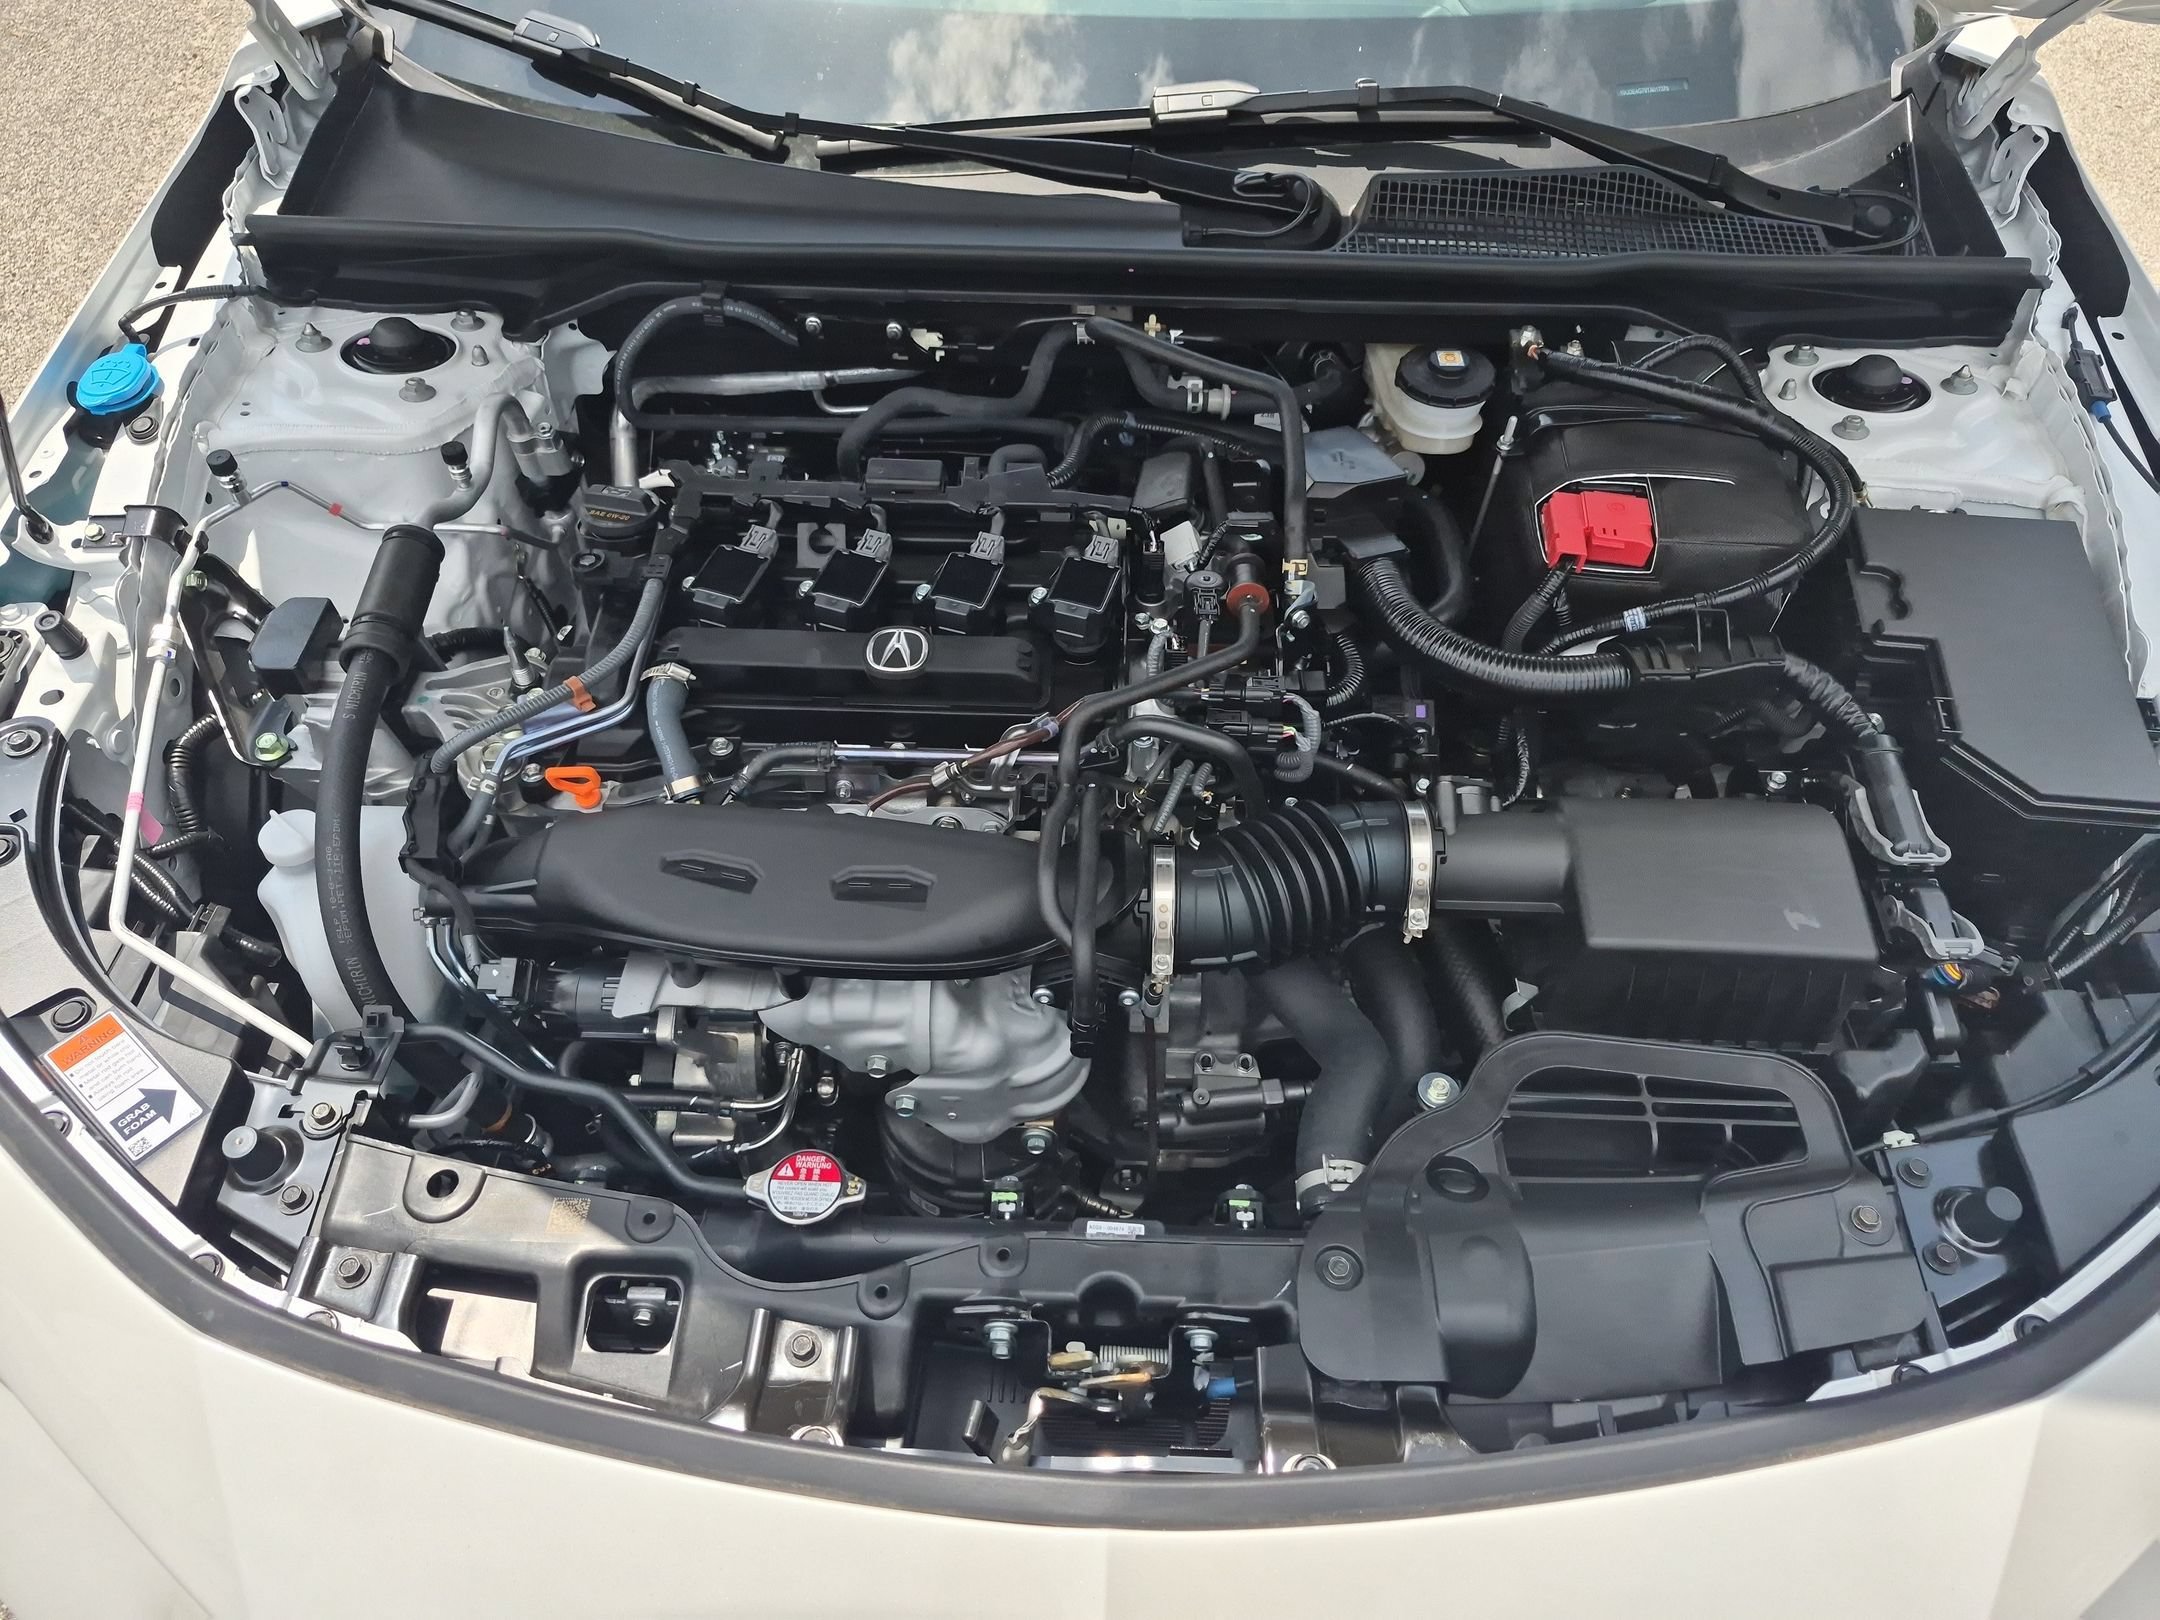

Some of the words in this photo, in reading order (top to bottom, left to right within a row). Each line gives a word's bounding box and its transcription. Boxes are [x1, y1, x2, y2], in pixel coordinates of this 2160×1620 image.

[589, 509, 605, 517] SAE
[606, 512, 631, 520] 0W-20
[344, 671, 368, 709] NICHIRIN
[62, 1027, 116, 1065] WARNING
[117, 1103, 150, 1127] GRAB
[123, 1108, 157, 1135] FOAM
[795, 1161, 832, 1169] WARNUNG
[796, 1155, 826, 1163] DANGER
